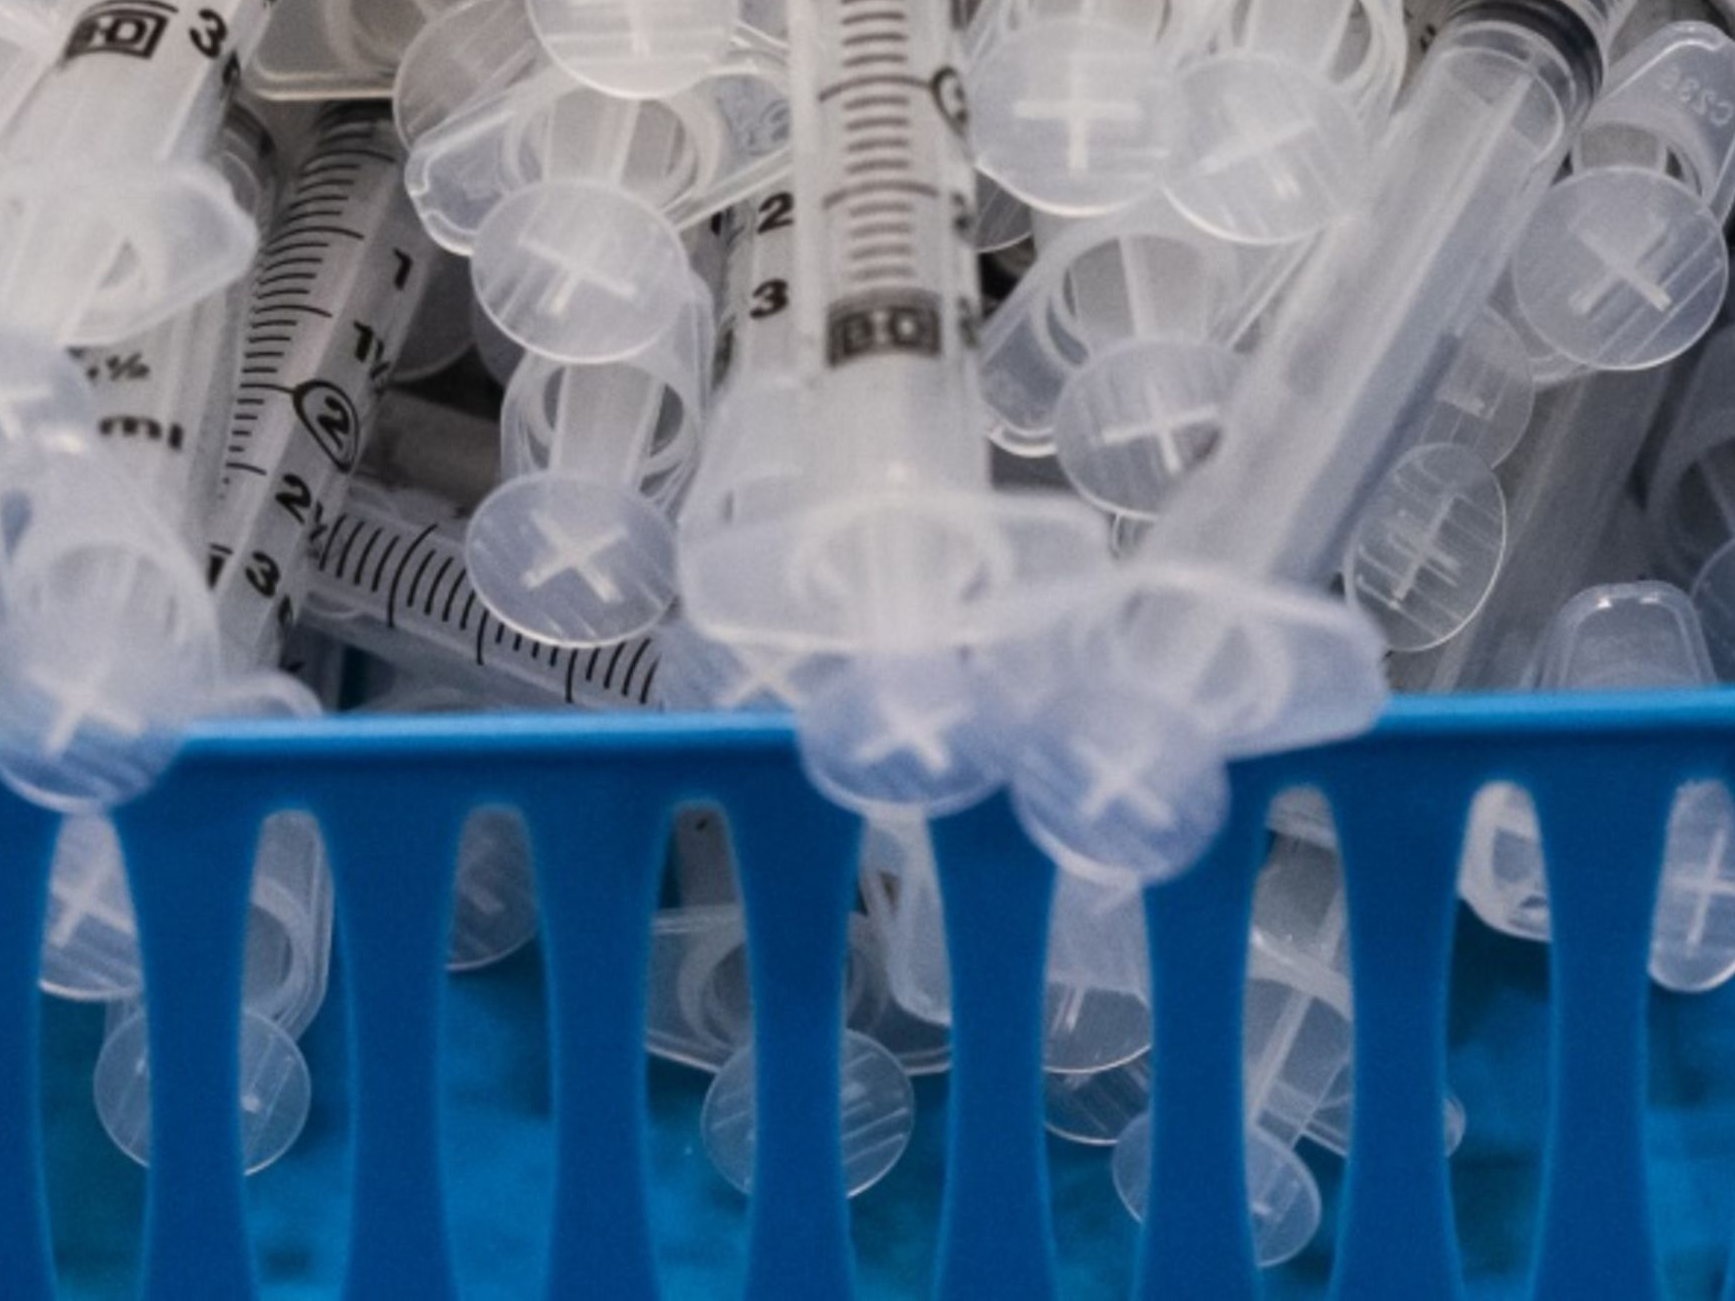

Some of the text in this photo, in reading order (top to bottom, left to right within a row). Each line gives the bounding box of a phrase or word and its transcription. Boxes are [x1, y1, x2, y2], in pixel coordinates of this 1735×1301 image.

[189, 8, 228, 59] 3
[750, 278, 790, 320] 3
[316, 395, 349, 451] 2
